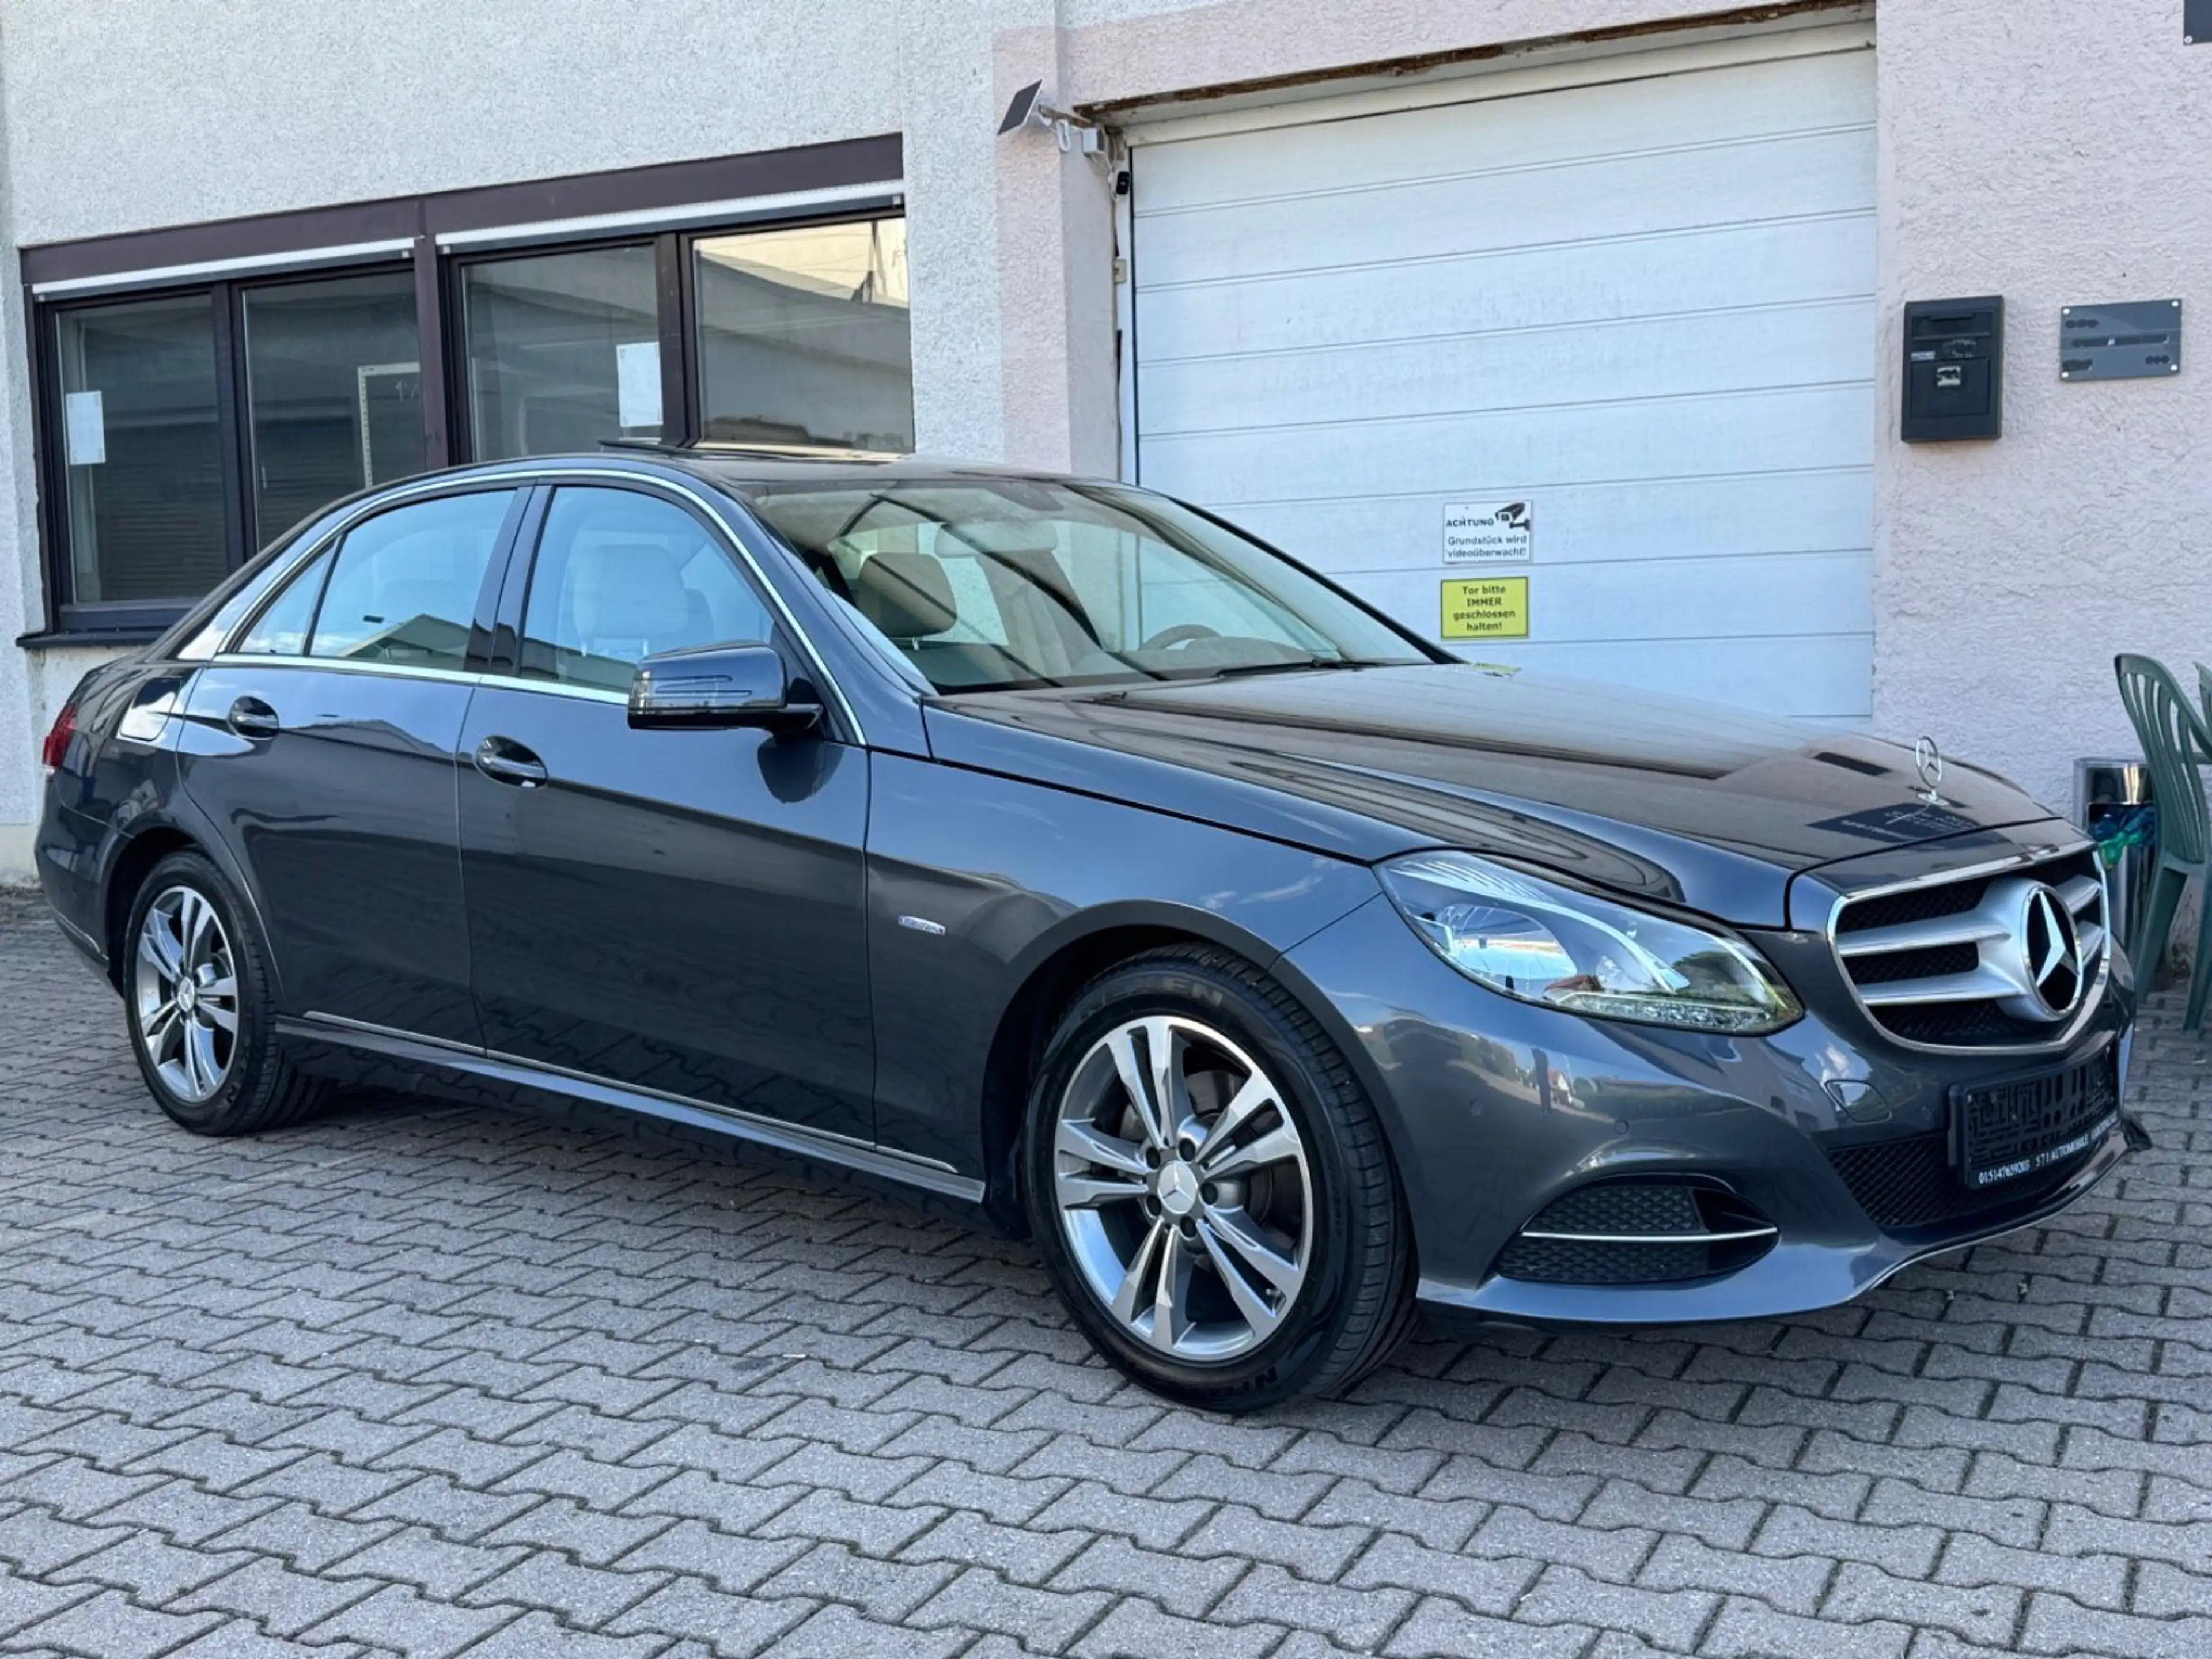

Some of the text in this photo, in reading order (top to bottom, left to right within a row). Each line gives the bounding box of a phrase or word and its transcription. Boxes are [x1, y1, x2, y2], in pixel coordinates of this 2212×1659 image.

[1446, 518, 1494, 527] ACHTUNG
[1447, 534, 1527, 546] Grundstück wird
[1447, 547, 1527, 558] videoüberwacht!
[1462, 585, 1507, 595] Tor bitte
[1467, 597, 1502, 607] IMMER
[1453, 609, 1516, 622] geschlossen
[1467, 622, 1502, 631] halten!
